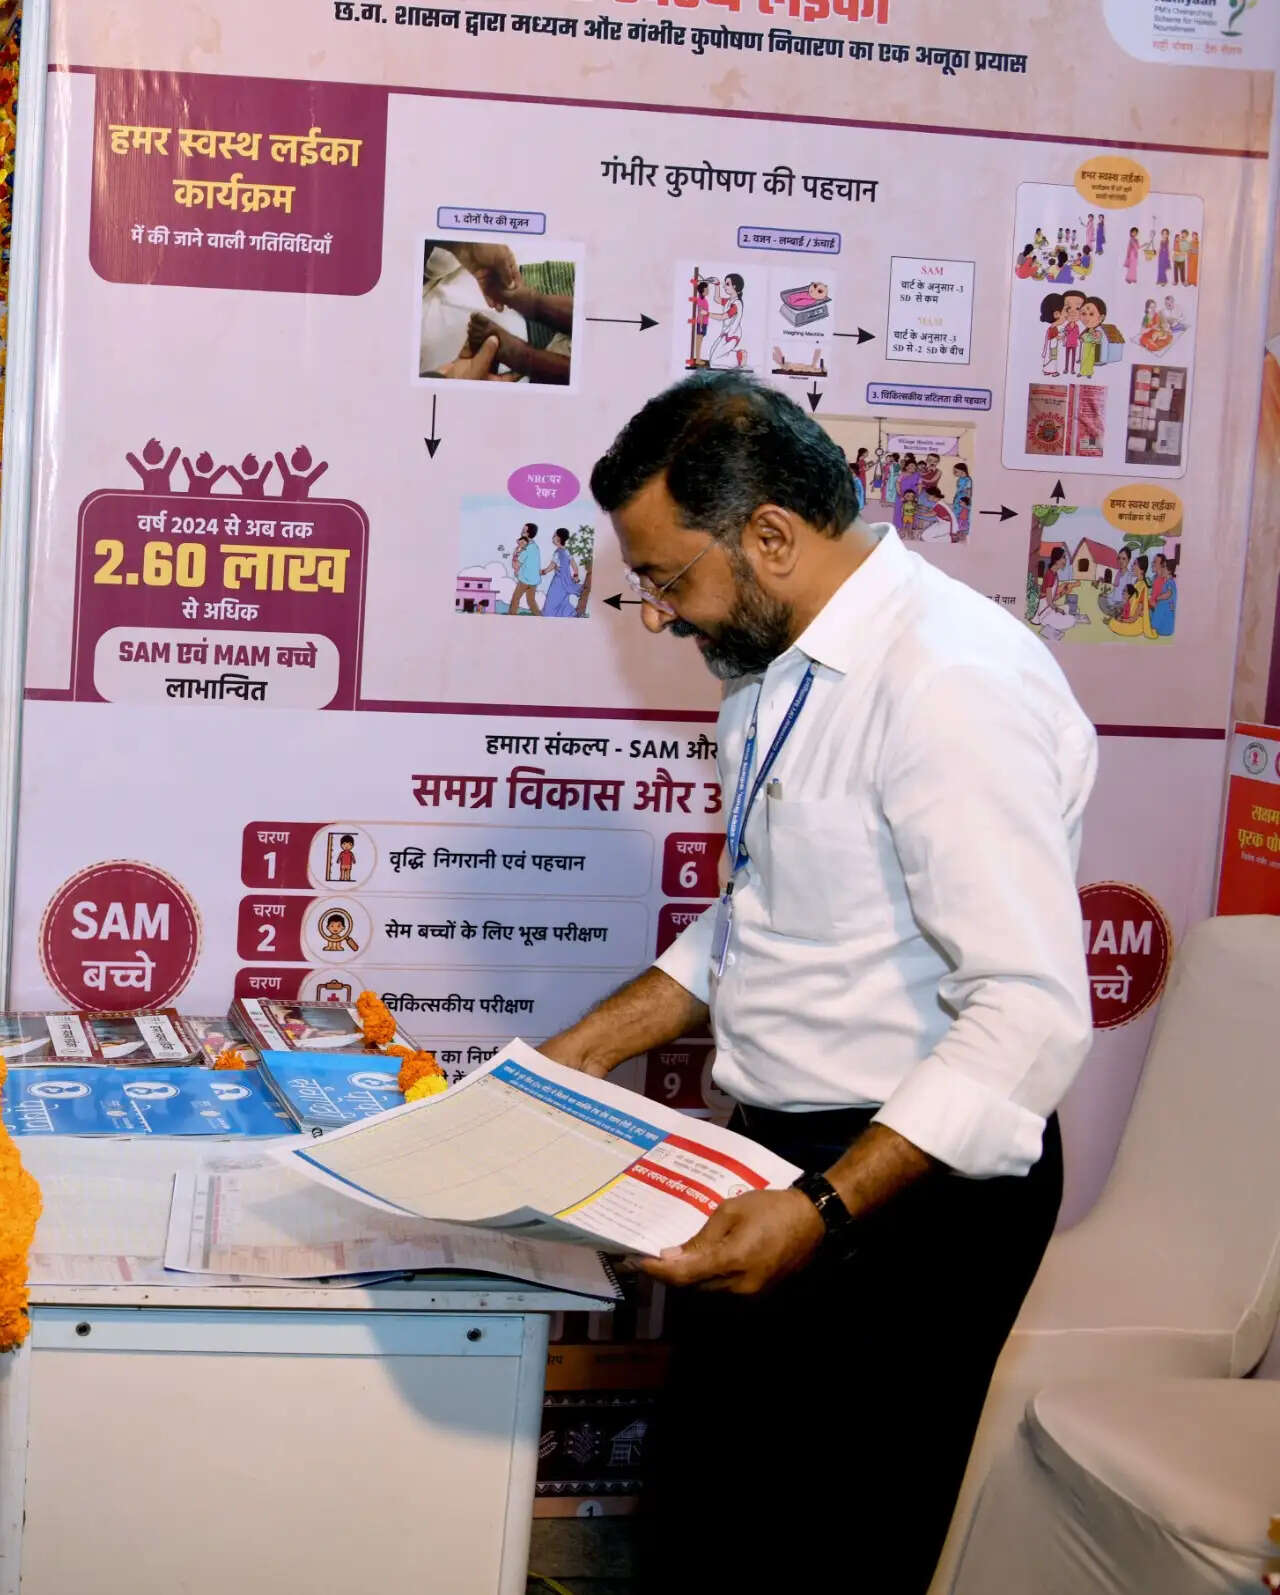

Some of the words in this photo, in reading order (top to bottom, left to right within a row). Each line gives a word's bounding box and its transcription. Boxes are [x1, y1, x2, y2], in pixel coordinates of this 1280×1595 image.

[334, 1, 387, 24] छ.ग.
[395, 5, 460, 28] शासन
[465, 10, 506, 36] द्वारा
[511, 13, 578, 37] मध्यम
[584, 15, 622, 41] और
[627, 18, 686, 46] गंभीर
[691, 25, 763, 55] कुपोषण
[769, 28, 844, 58] निवारण
[849, 40, 874, 61] का
[878, 42, 910, 63] एक
[915, 46, 969, 75] अनूठा
[975, 50, 1027, 74] प्रयास
[108, 124, 171, 156] हमर
[178, 128, 262, 161] स्वस्थ
[269, 127, 363, 167] लईका
[601, 155, 659, 187] गंभीर
[664, 160, 757, 198] कुपोषण
[762, 166, 796, 196] की
[802, 174, 878, 203] पहचान
[172, 173, 296, 213] कार्यक्रम
[495, 215, 507, 227] की
[509, 217, 530, 229] सूजन
[131, 224, 145, 244] में
[147, 225, 169, 246] की
[173, 228, 203, 249] जाने
[207, 230, 245, 250] वाली
[249, 231, 334, 255] गतिविधियाँ
[743, 234, 751, 243] 2.
[753, 234, 771, 245] वजन
[920, 266, 944, 276] SAM
[928, 282, 955, 294] अनुसार
[920, 332, 948, 344] अनुसार
[138, 511, 167, 533] वर्ष
[171, 516, 219, 536] 2024
[224, 513, 241, 536] से
[245, 519, 278, 538] अब
[281, 521, 314, 539] तक
[94, 539, 207, 588] 2.60
[220, 543, 350, 593] लाख
[182, 597, 200, 620] से
[204, 598, 260, 621] अधिक
[119, 640, 171, 663] SAM
[177, 637, 208, 665] एवं
[214, 644, 270, 667] MAM
[276, 641, 318, 669] बच्चे
[165, 673, 268, 702] लाभान्वित
[485, 734, 539, 755] हमारा
[545, 731, 609, 757] संकल्प
[629, 739, 680, 760] SAM
[686, 734, 718, 761] और
[412, 774, 498, 809] समग्र
[506, 766, 624, 811] विकास
[634, 768, 696, 814] और
[257, 829, 290, 845] चरण
[677, 841, 707, 854] चरण
[263, 852, 277, 880] 1
[390, 847, 425, 873] वृद्धि
[433, 847, 496, 871] निगरानी
[502, 850, 526, 870] एवं
[532, 854, 585, 871] पहचान
[678, 861, 699, 888] 6
[71, 901, 170, 941] SAM
[252, 903, 286, 919] चरण
[256, 924, 277, 952] 2
[384, 920, 411, 940] सेम
[417, 919, 458, 940] बच्चों
[462, 921, 477, 940] के
[482, 921, 514, 941] लिए
[518, 925, 549, 945] भूख
[553, 924, 608, 944] परीक्षण
[81, 950, 156, 992] बच्चे
[250, 975, 280, 991] चरण
[1088, 965, 1132, 1003] च्चे
[385, 992, 475, 1015] चिकित्सकीय
[480, 996, 534, 1016] परीक्षण
[441, 1050, 462, 1064] का
[660, 1054, 689, 1065] चरण
[664, 1073, 681, 1098] 9
